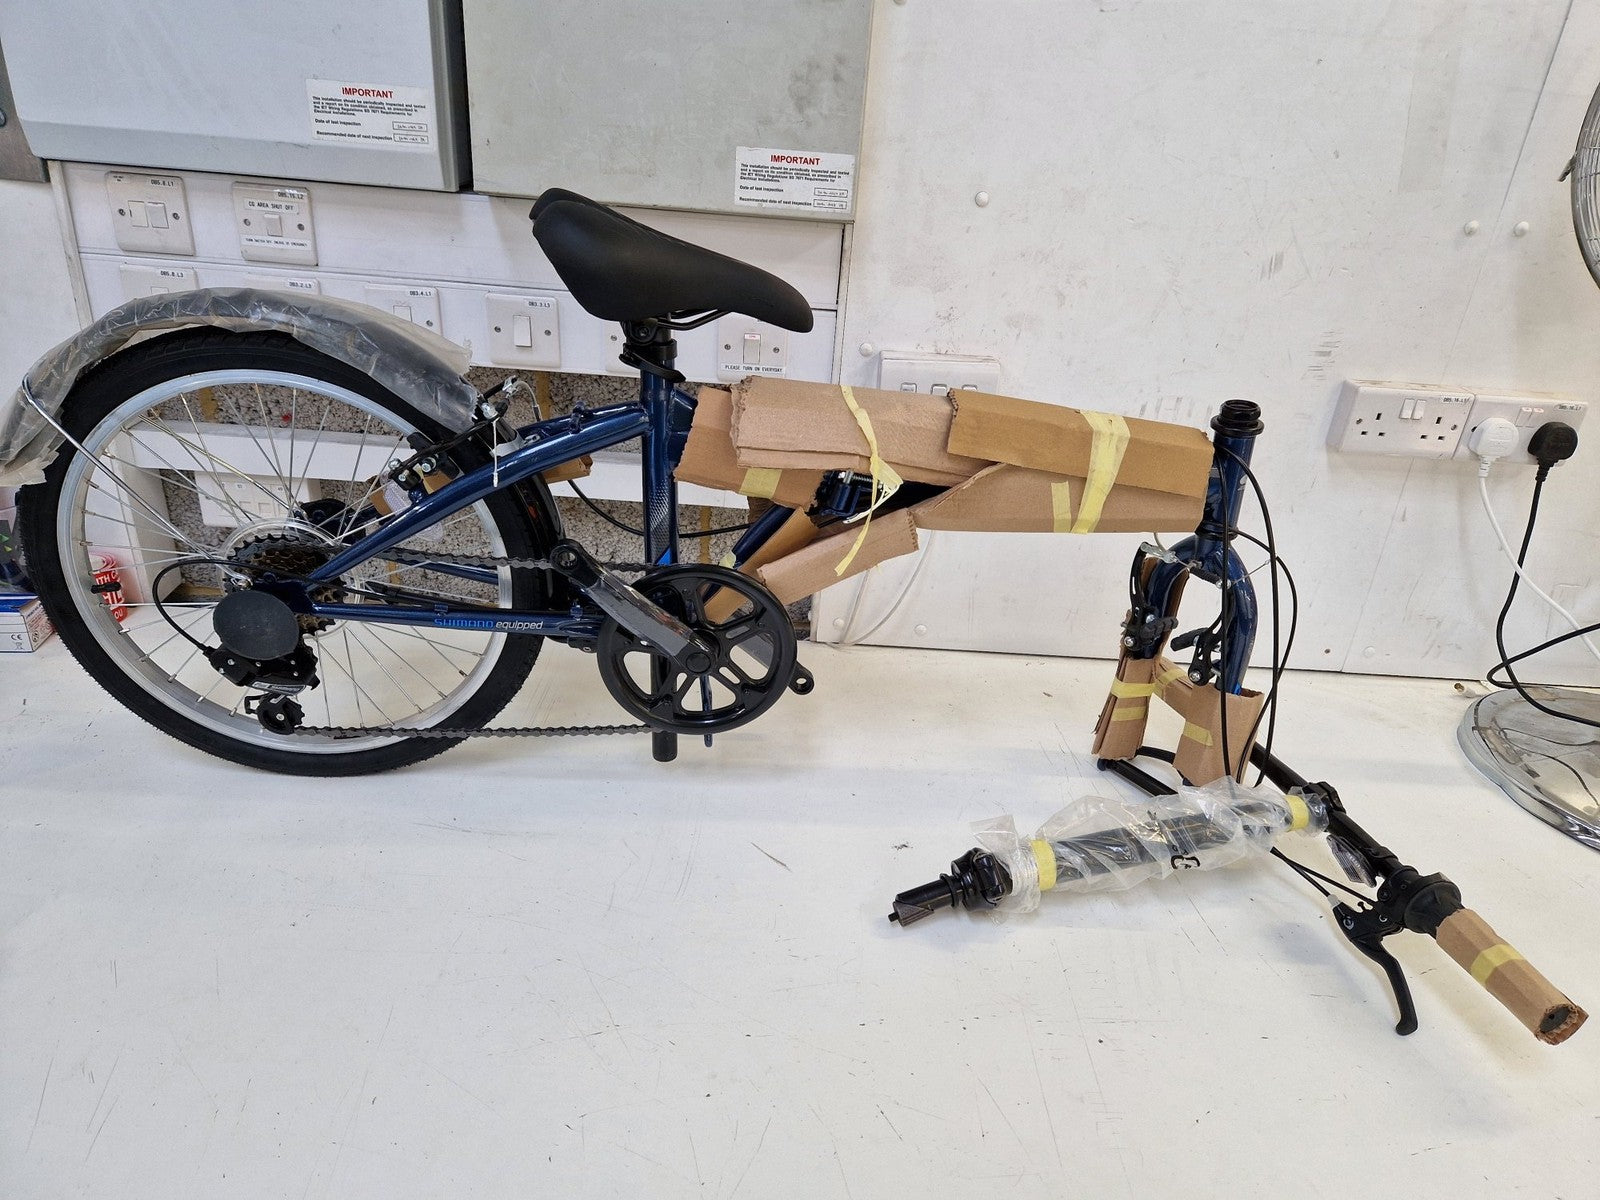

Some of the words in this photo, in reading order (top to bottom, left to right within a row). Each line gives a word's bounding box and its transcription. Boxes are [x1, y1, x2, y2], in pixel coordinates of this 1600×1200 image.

[342, 87, 393, 98] IMPORTANT
[770, 154, 820, 166] IMPORTANT
[434, 618, 494, 630] SHIMANO
[496, 620, 544, 631] equipped
